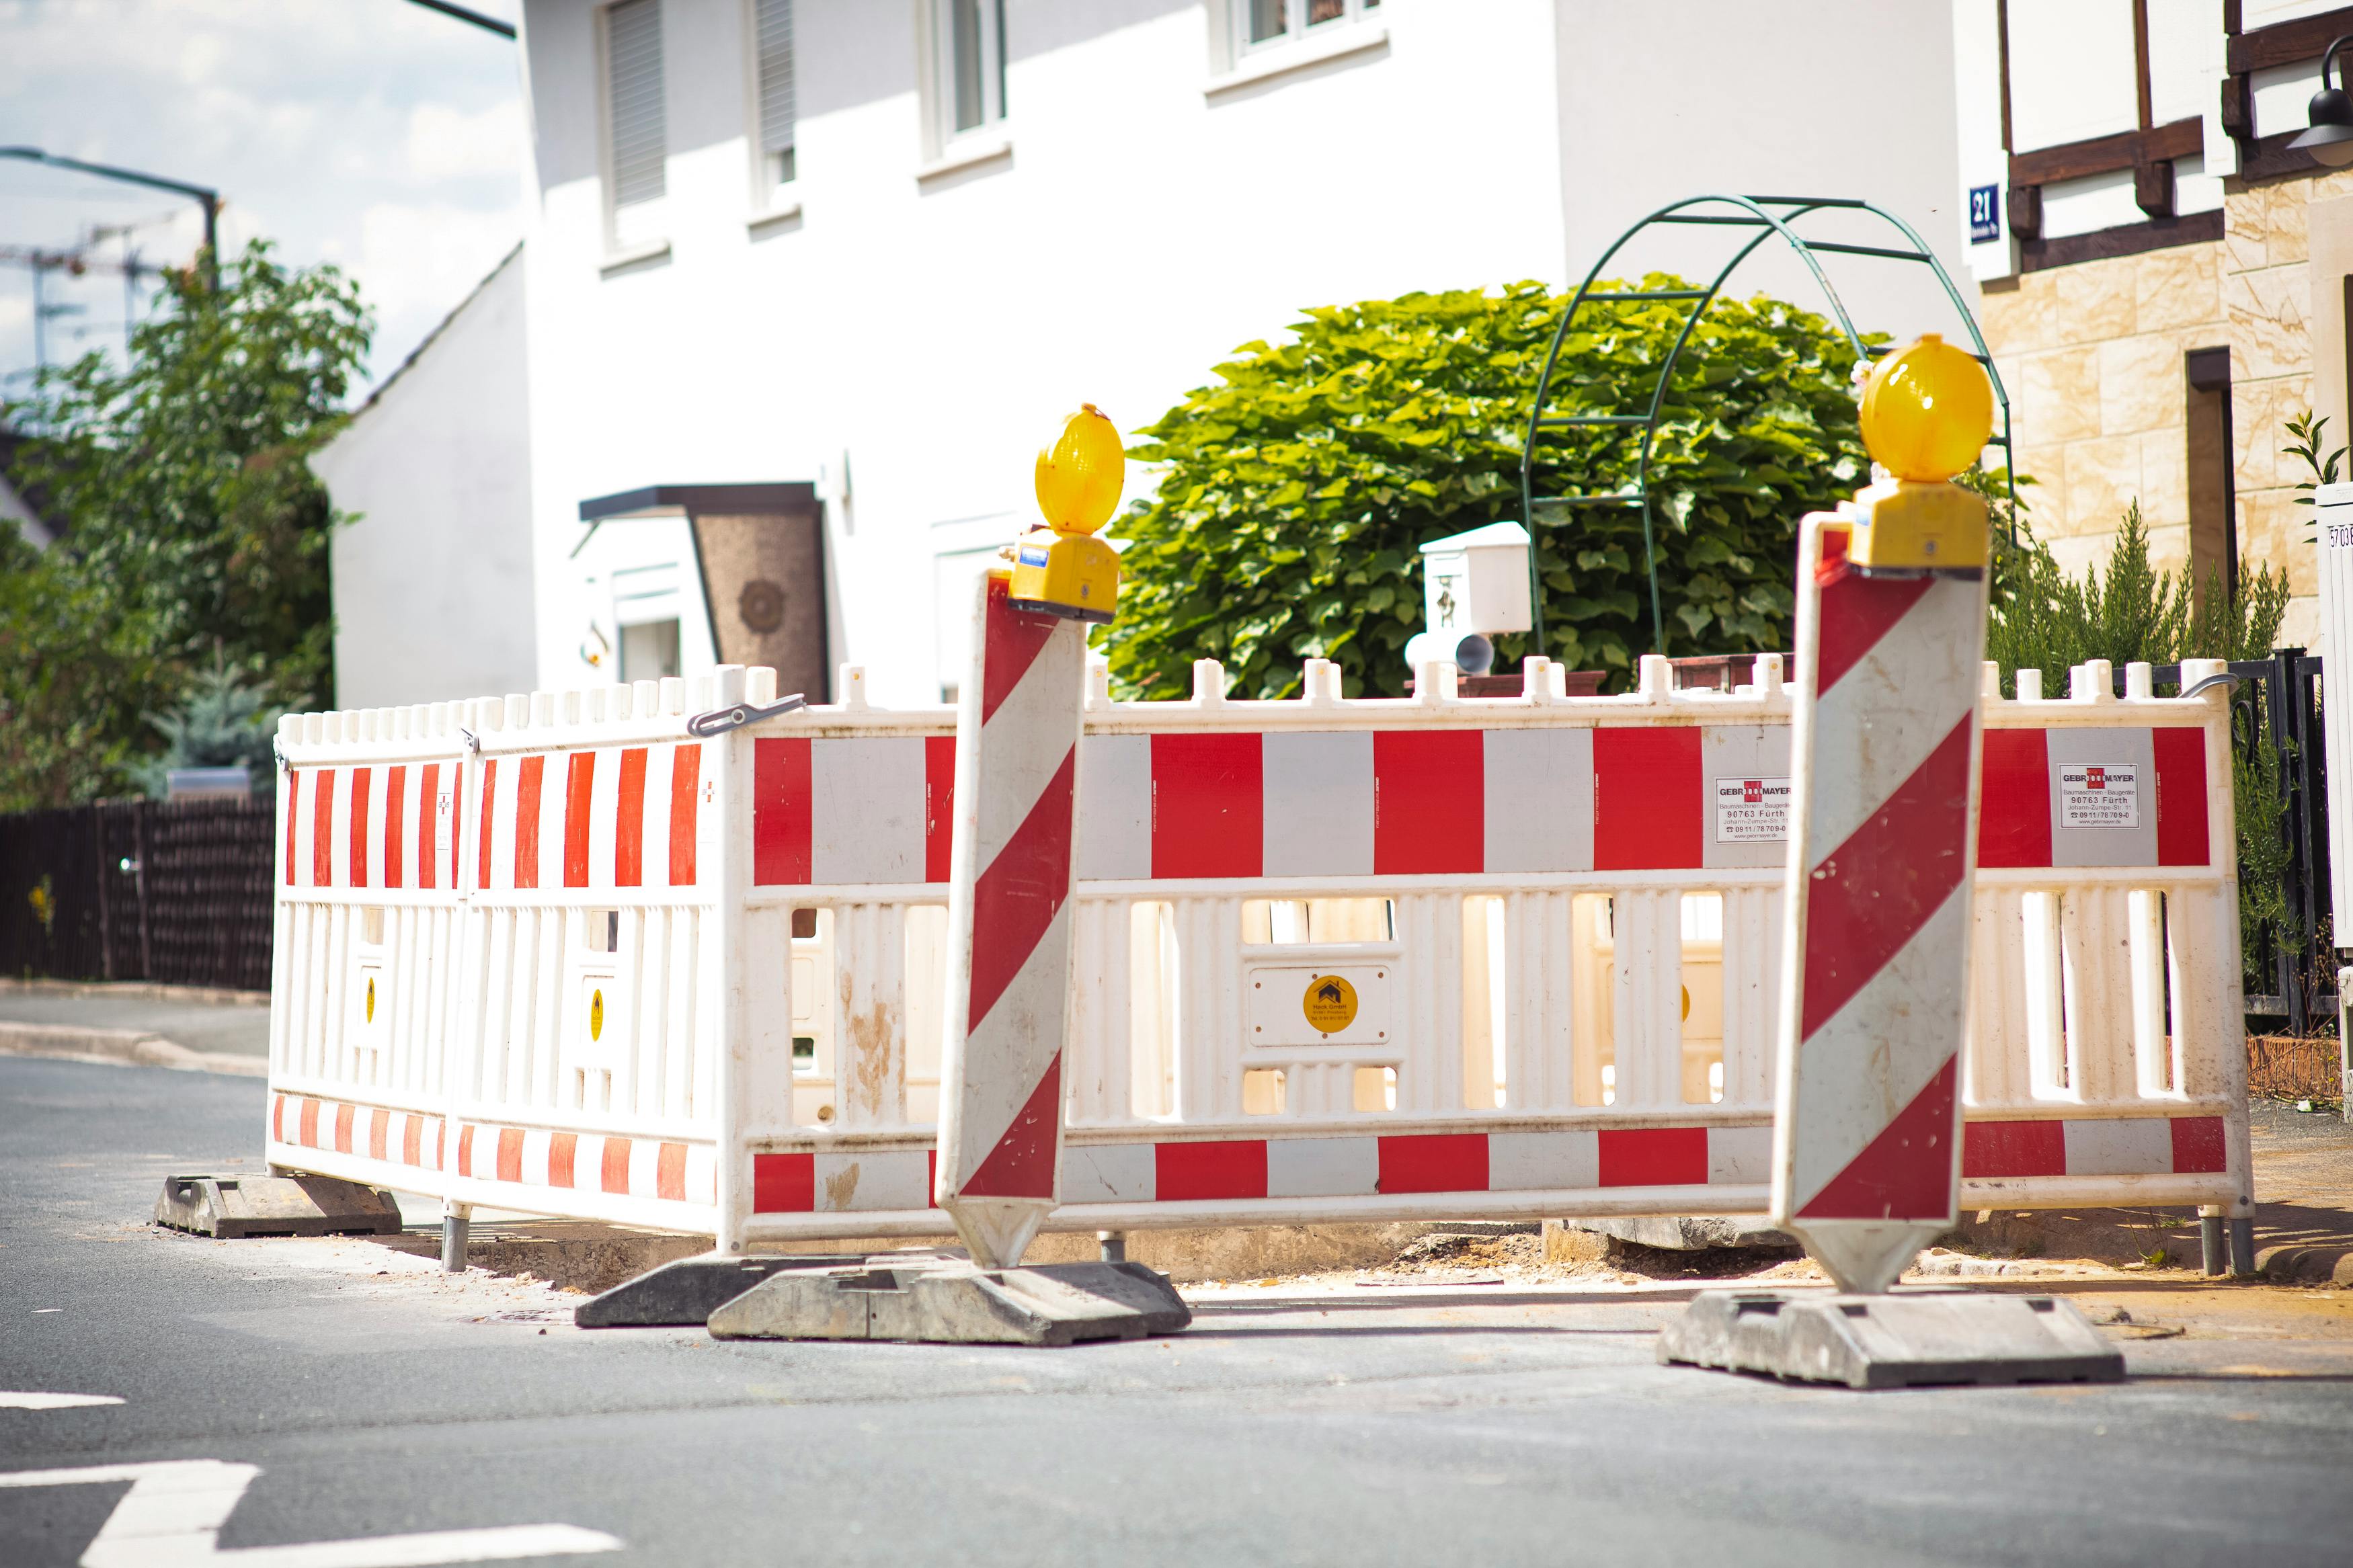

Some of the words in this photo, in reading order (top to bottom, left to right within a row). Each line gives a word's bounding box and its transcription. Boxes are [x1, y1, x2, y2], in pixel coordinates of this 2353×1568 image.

[1973, 191, 1991, 222] 21
[1720, 788, 1744, 796] GEBR
[1762, 787, 1791, 795] MAYER
